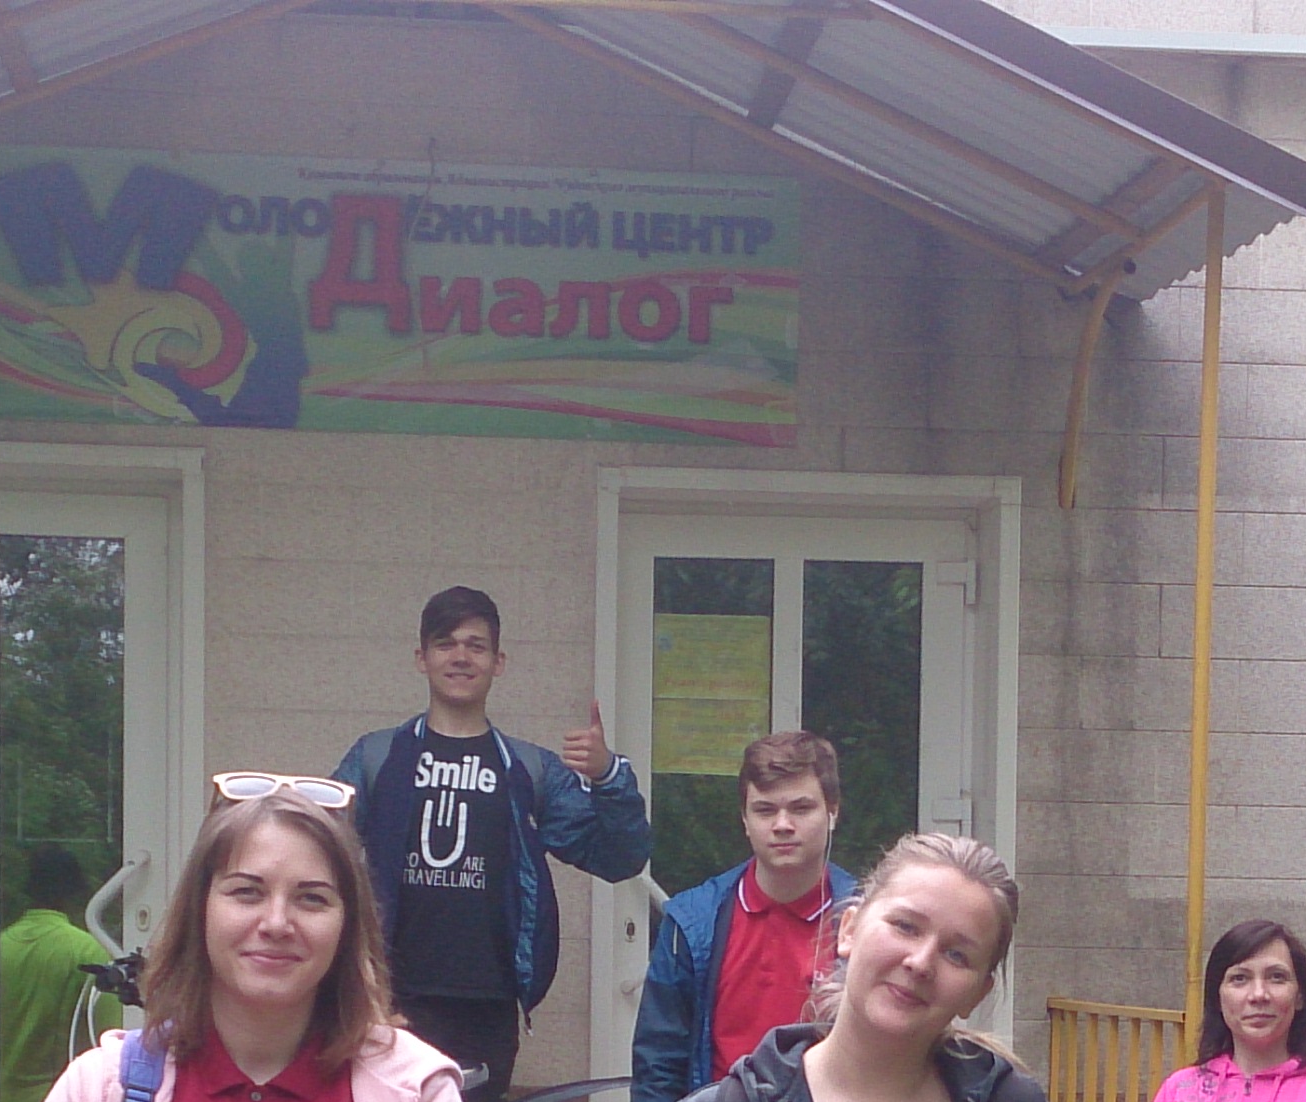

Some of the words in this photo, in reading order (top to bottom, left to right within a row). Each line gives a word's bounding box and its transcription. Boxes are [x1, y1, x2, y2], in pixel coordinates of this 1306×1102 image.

[612, 210, 774, 257] ЦЕНТР
[309, 194, 734, 344] Диалог
[414, 751, 497, 793] Smile
